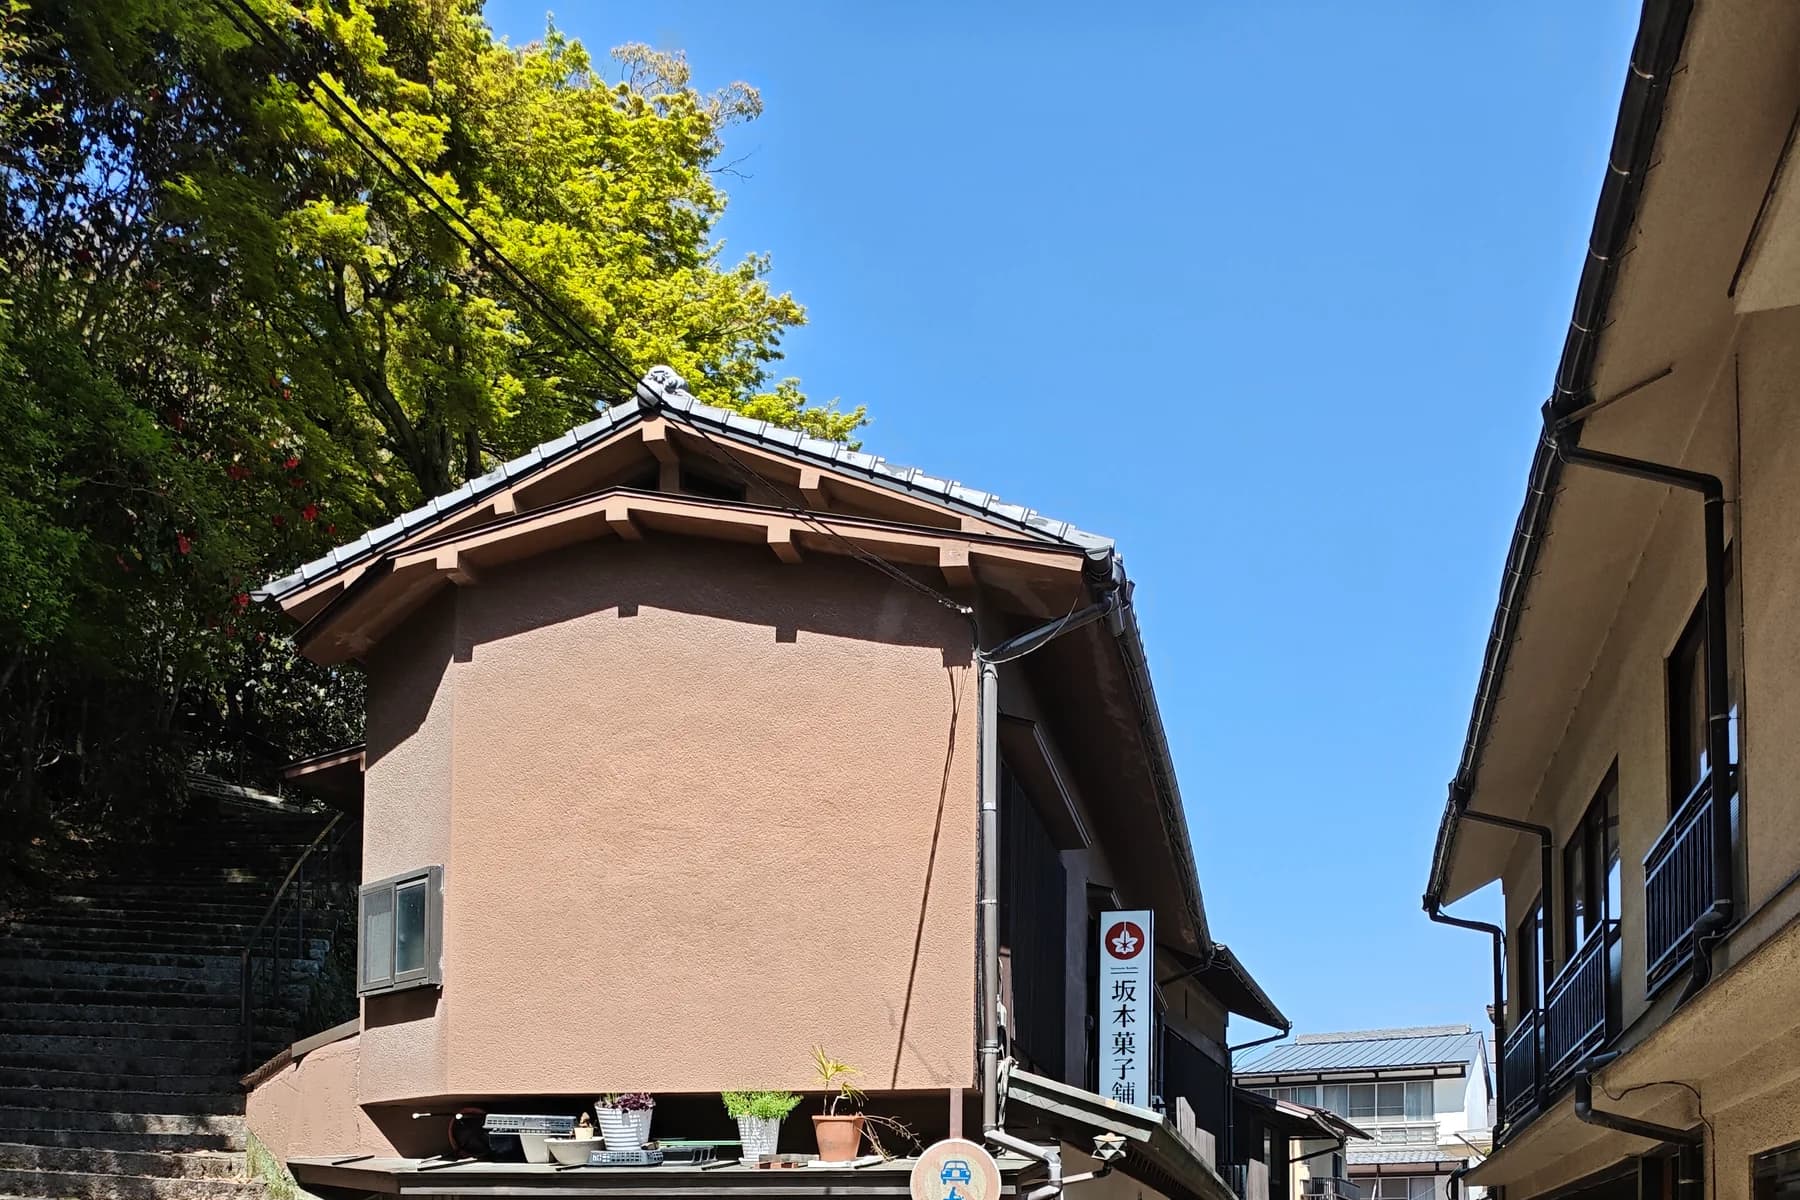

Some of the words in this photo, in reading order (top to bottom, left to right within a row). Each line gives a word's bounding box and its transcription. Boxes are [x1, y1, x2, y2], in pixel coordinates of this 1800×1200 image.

[1111, 980, 1137, 1105] 坂本菓子舗
